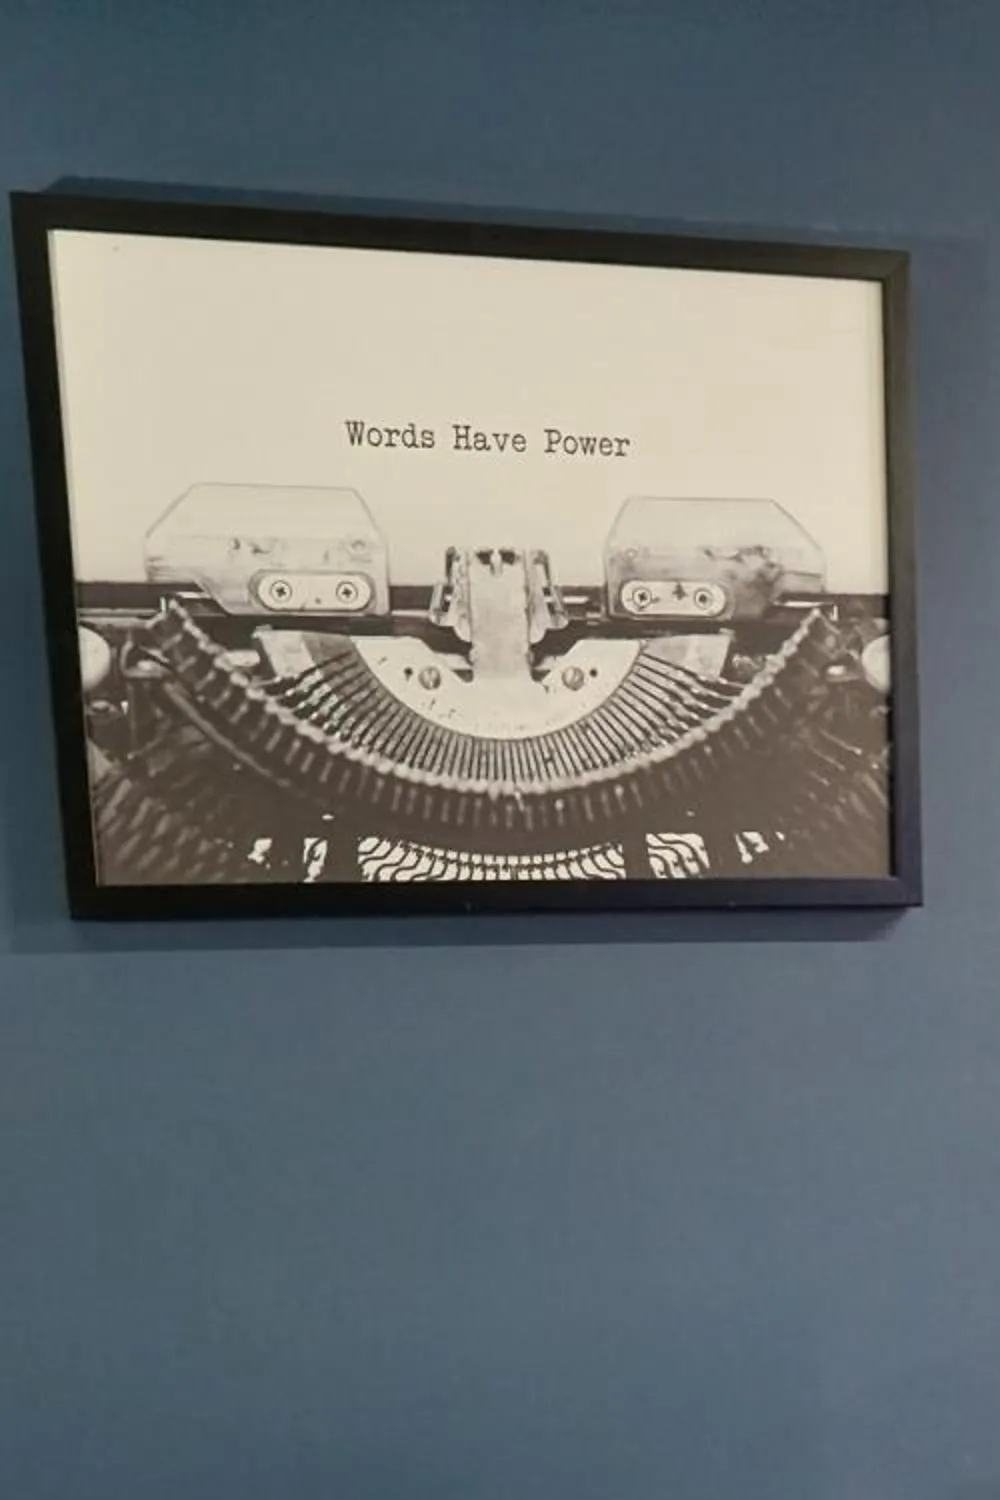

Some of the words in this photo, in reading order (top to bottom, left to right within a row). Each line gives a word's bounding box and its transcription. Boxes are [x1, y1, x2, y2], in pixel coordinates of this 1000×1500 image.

[345, 420, 436, 449] Words
[452, 424, 528, 453] Have
[544, 428, 631, 457] Power
